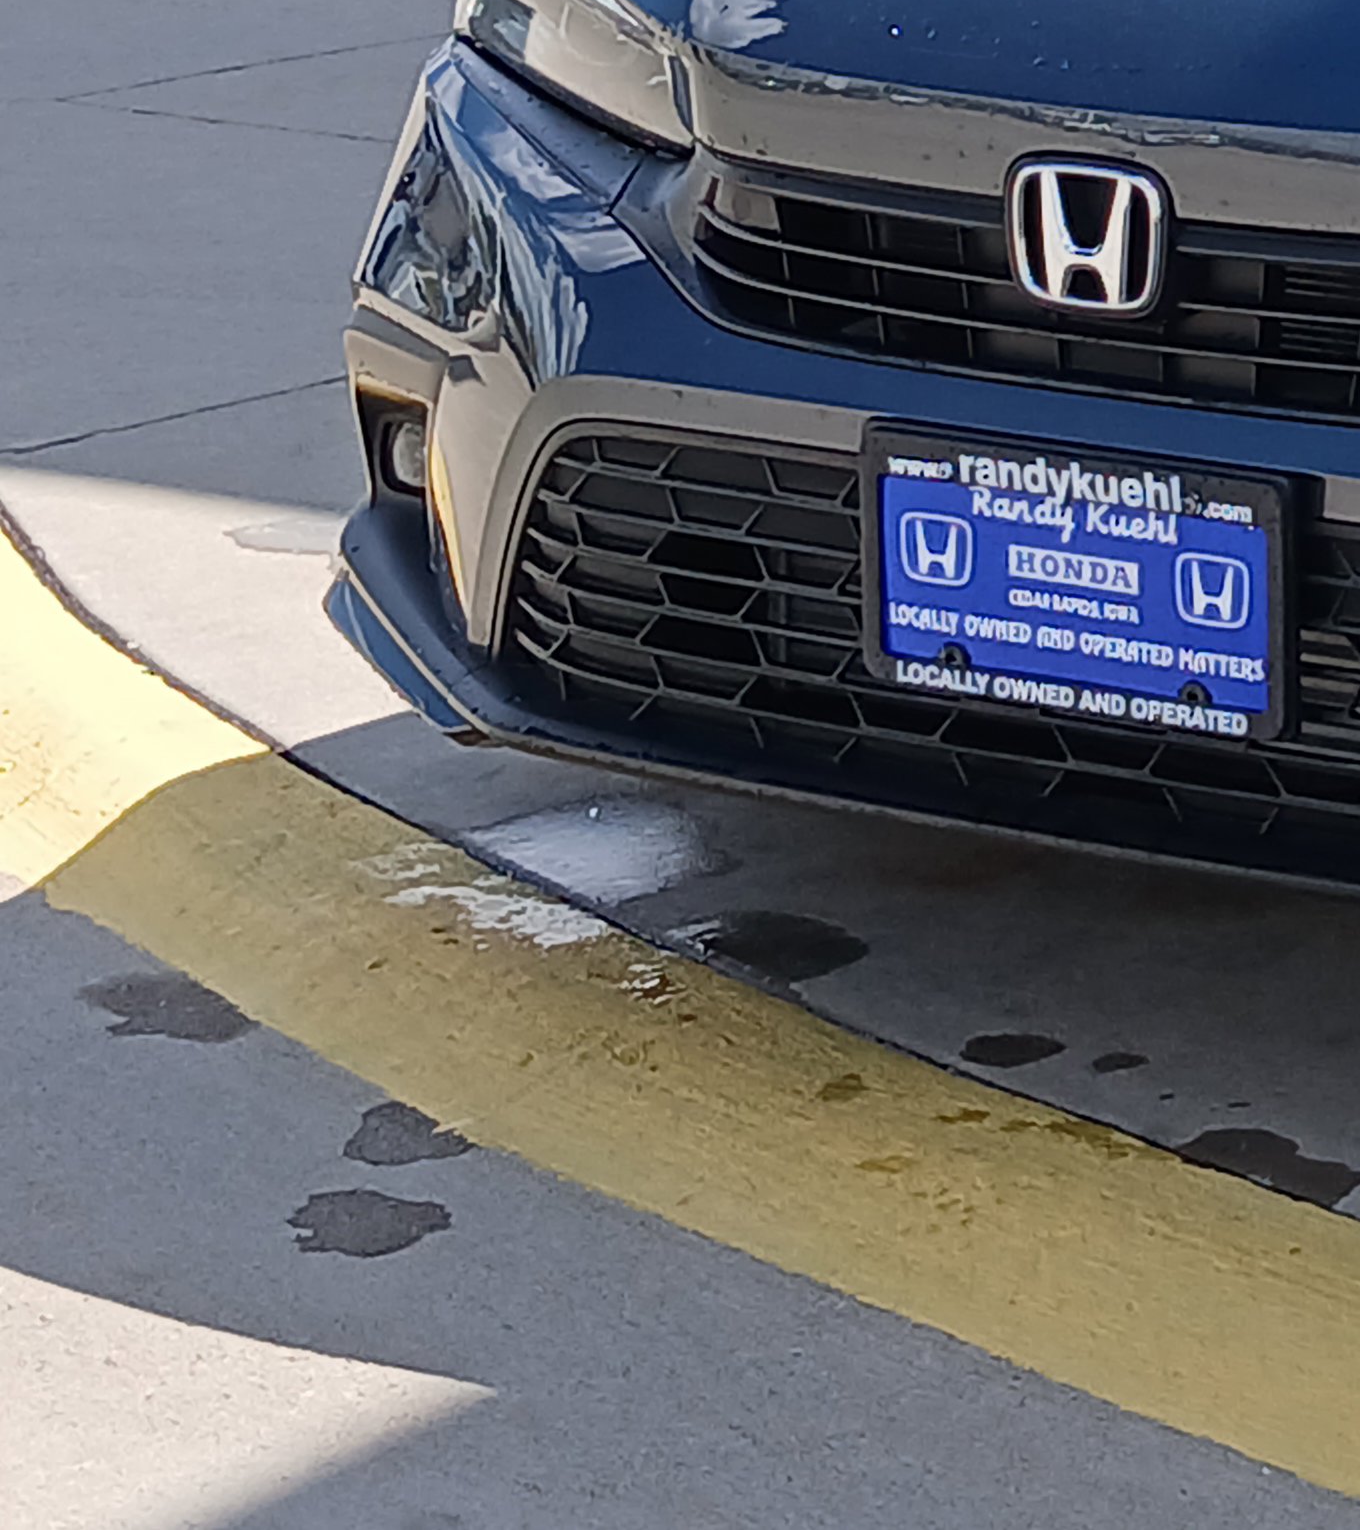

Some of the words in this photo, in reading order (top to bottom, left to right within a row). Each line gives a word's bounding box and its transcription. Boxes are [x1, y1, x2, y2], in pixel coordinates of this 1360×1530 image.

[959, 454, 1182, 513] randykuehl
[969, 486, 1075, 543] Randy
[1086, 502, 1178, 545] Kuehl
[1015, 550, 1132, 588] HONDA
[889, 601, 960, 636] LOCALLY
[964, 614, 1032, 644] OWNED
[1037, 626, 1075, 651] AND
[1079, 632, 1174, 667] OPERATED
[1178, 647, 1265, 682] MATTERS
[896, 660, 990, 695] LOCALLY
[993, 676, 1075, 708] OWNED
[1078, 690, 1126, 716] AND
[1130, 697, 1248, 736] OPERATED
